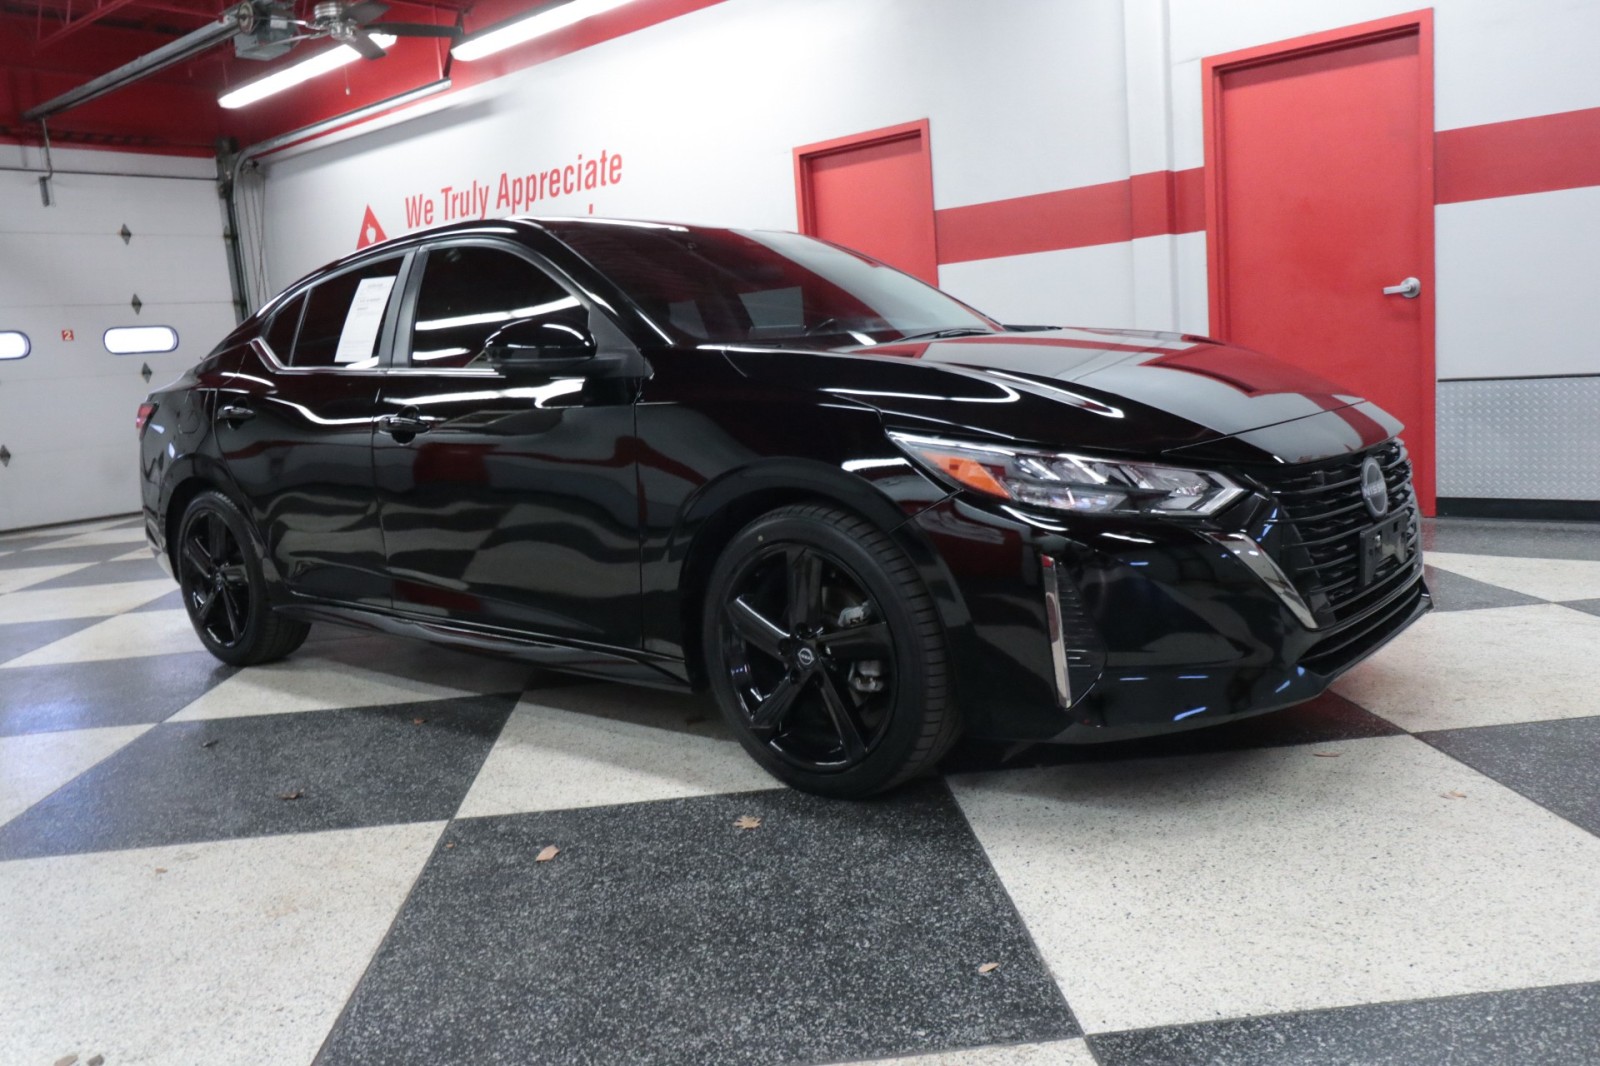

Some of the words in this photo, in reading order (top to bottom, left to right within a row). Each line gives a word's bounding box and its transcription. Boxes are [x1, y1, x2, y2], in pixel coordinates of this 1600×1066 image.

[405, 193, 434, 229] We
[441, 180, 490, 221] Truly
[496, 149, 623, 215] Appreciate
[63, 330, 73, 341] 2
